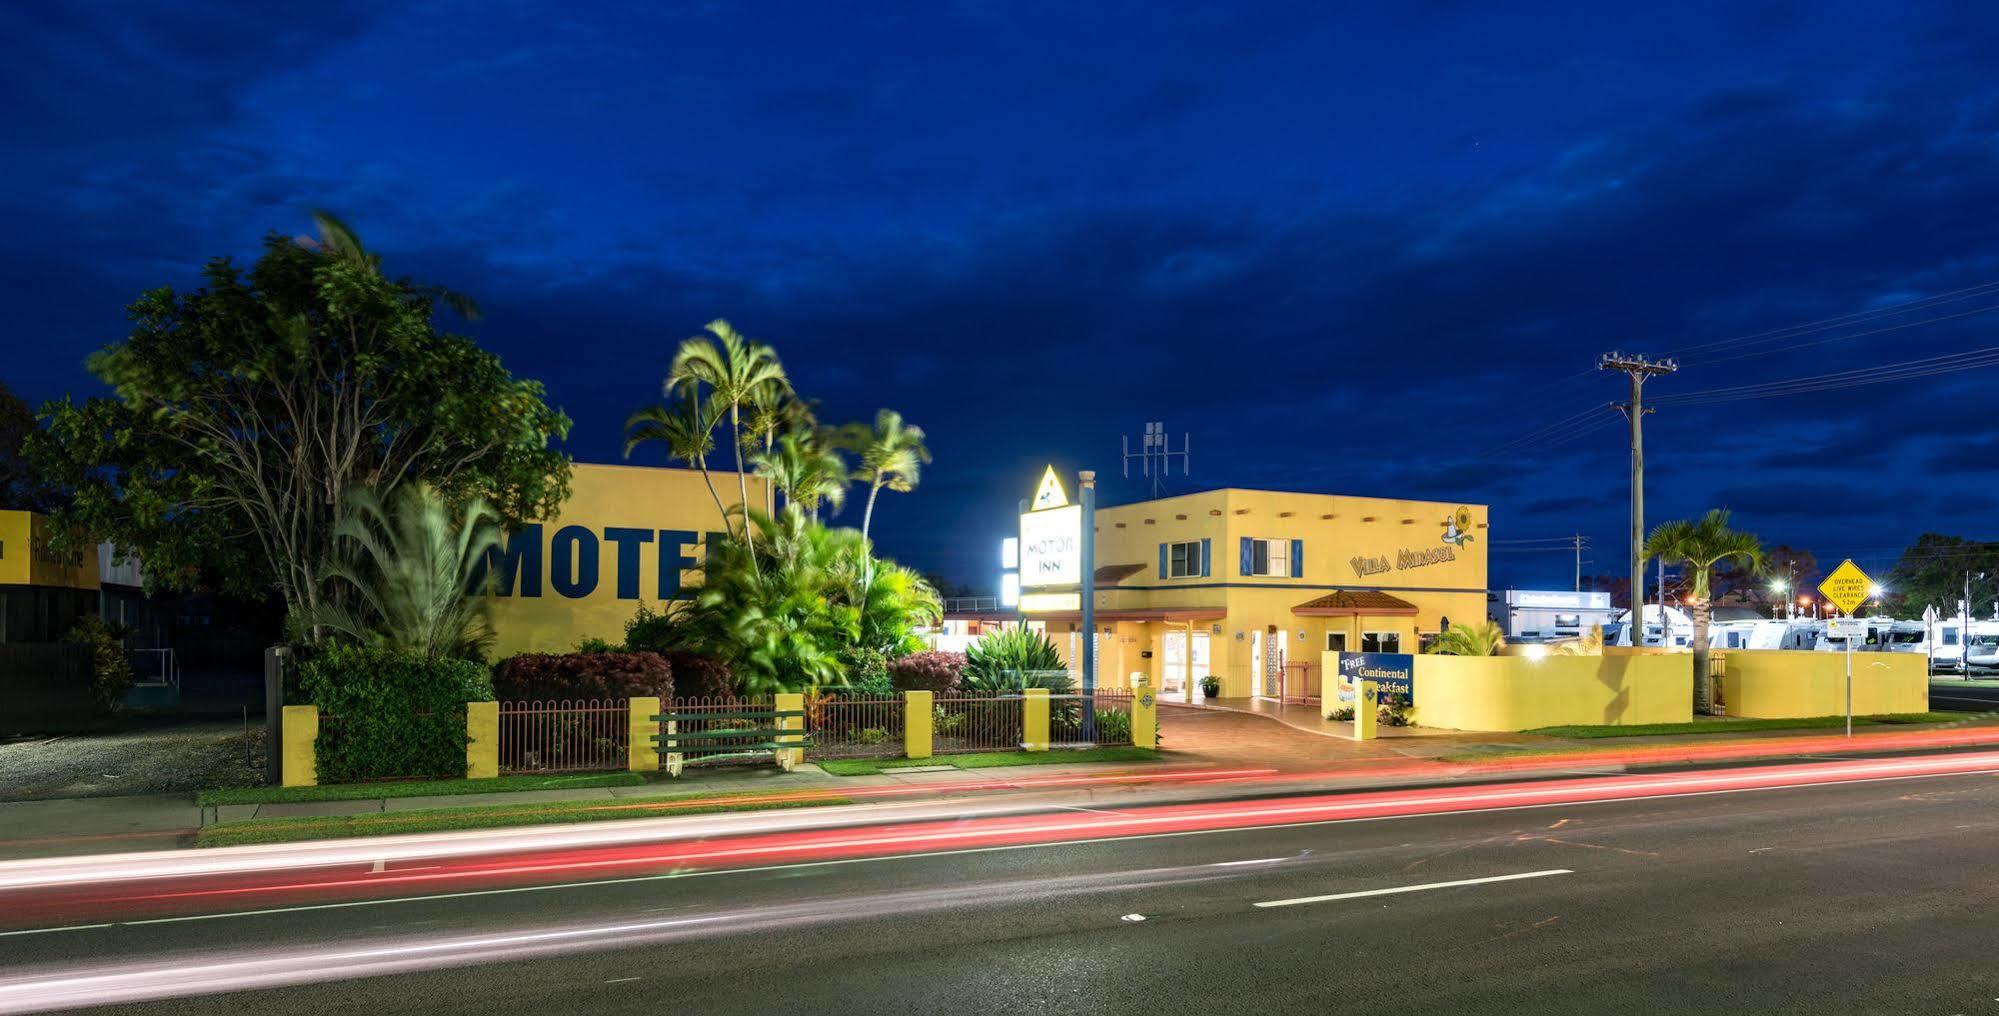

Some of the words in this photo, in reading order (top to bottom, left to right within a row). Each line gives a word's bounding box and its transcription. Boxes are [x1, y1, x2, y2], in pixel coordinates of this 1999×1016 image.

[1027, 536, 1074, 557] MOTOR
[1038, 560, 1062, 574] INN
[1350, 555, 1391, 578] VILLA
[1396, 546, 1455, 570] MIRASOL
[1344, 656, 1365, 670] FREE
[1358, 667, 1408, 679] Continental
[1366, 681, 1409, 694] eakfast
